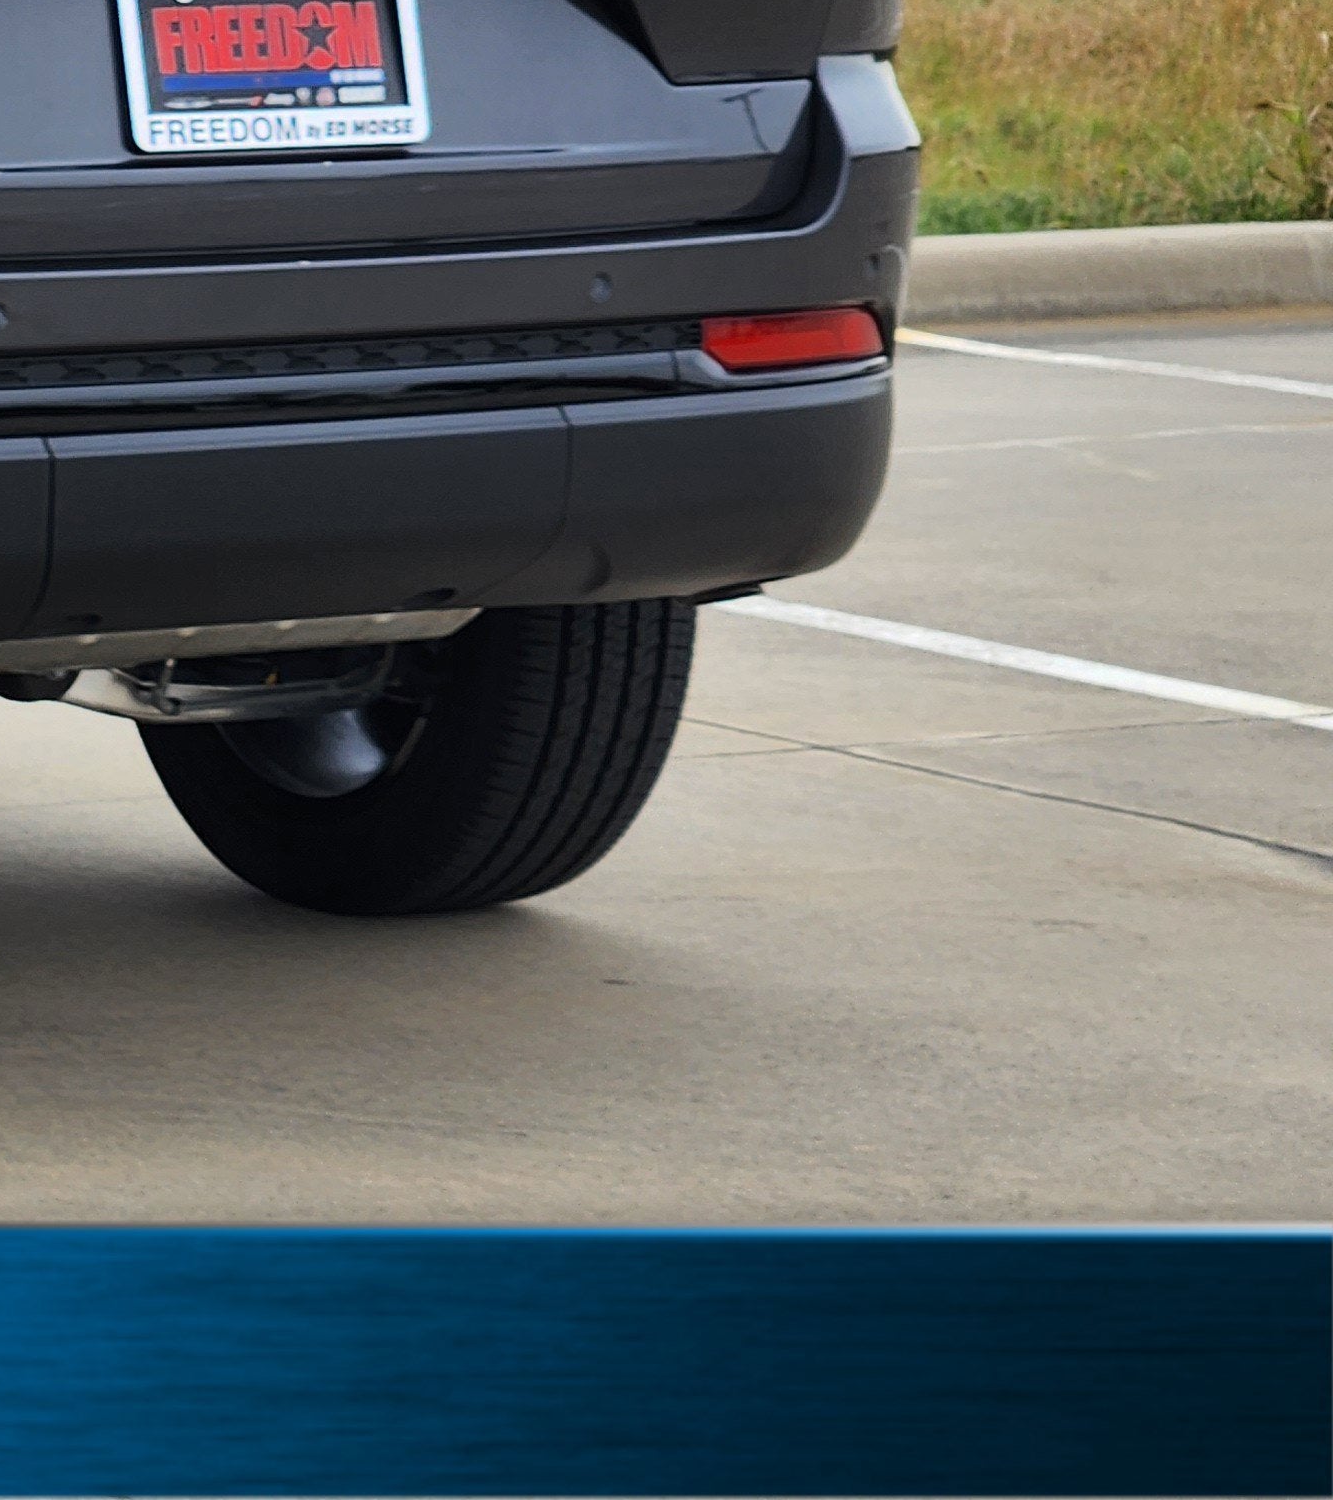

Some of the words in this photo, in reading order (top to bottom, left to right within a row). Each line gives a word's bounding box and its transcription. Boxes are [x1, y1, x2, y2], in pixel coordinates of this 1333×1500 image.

[151, 0, 383, 74] FREEDOM
[148, 116, 299, 146] FREEDOM
[326, 120, 346, 137] ED
[353, 118, 413, 136] MORSE
